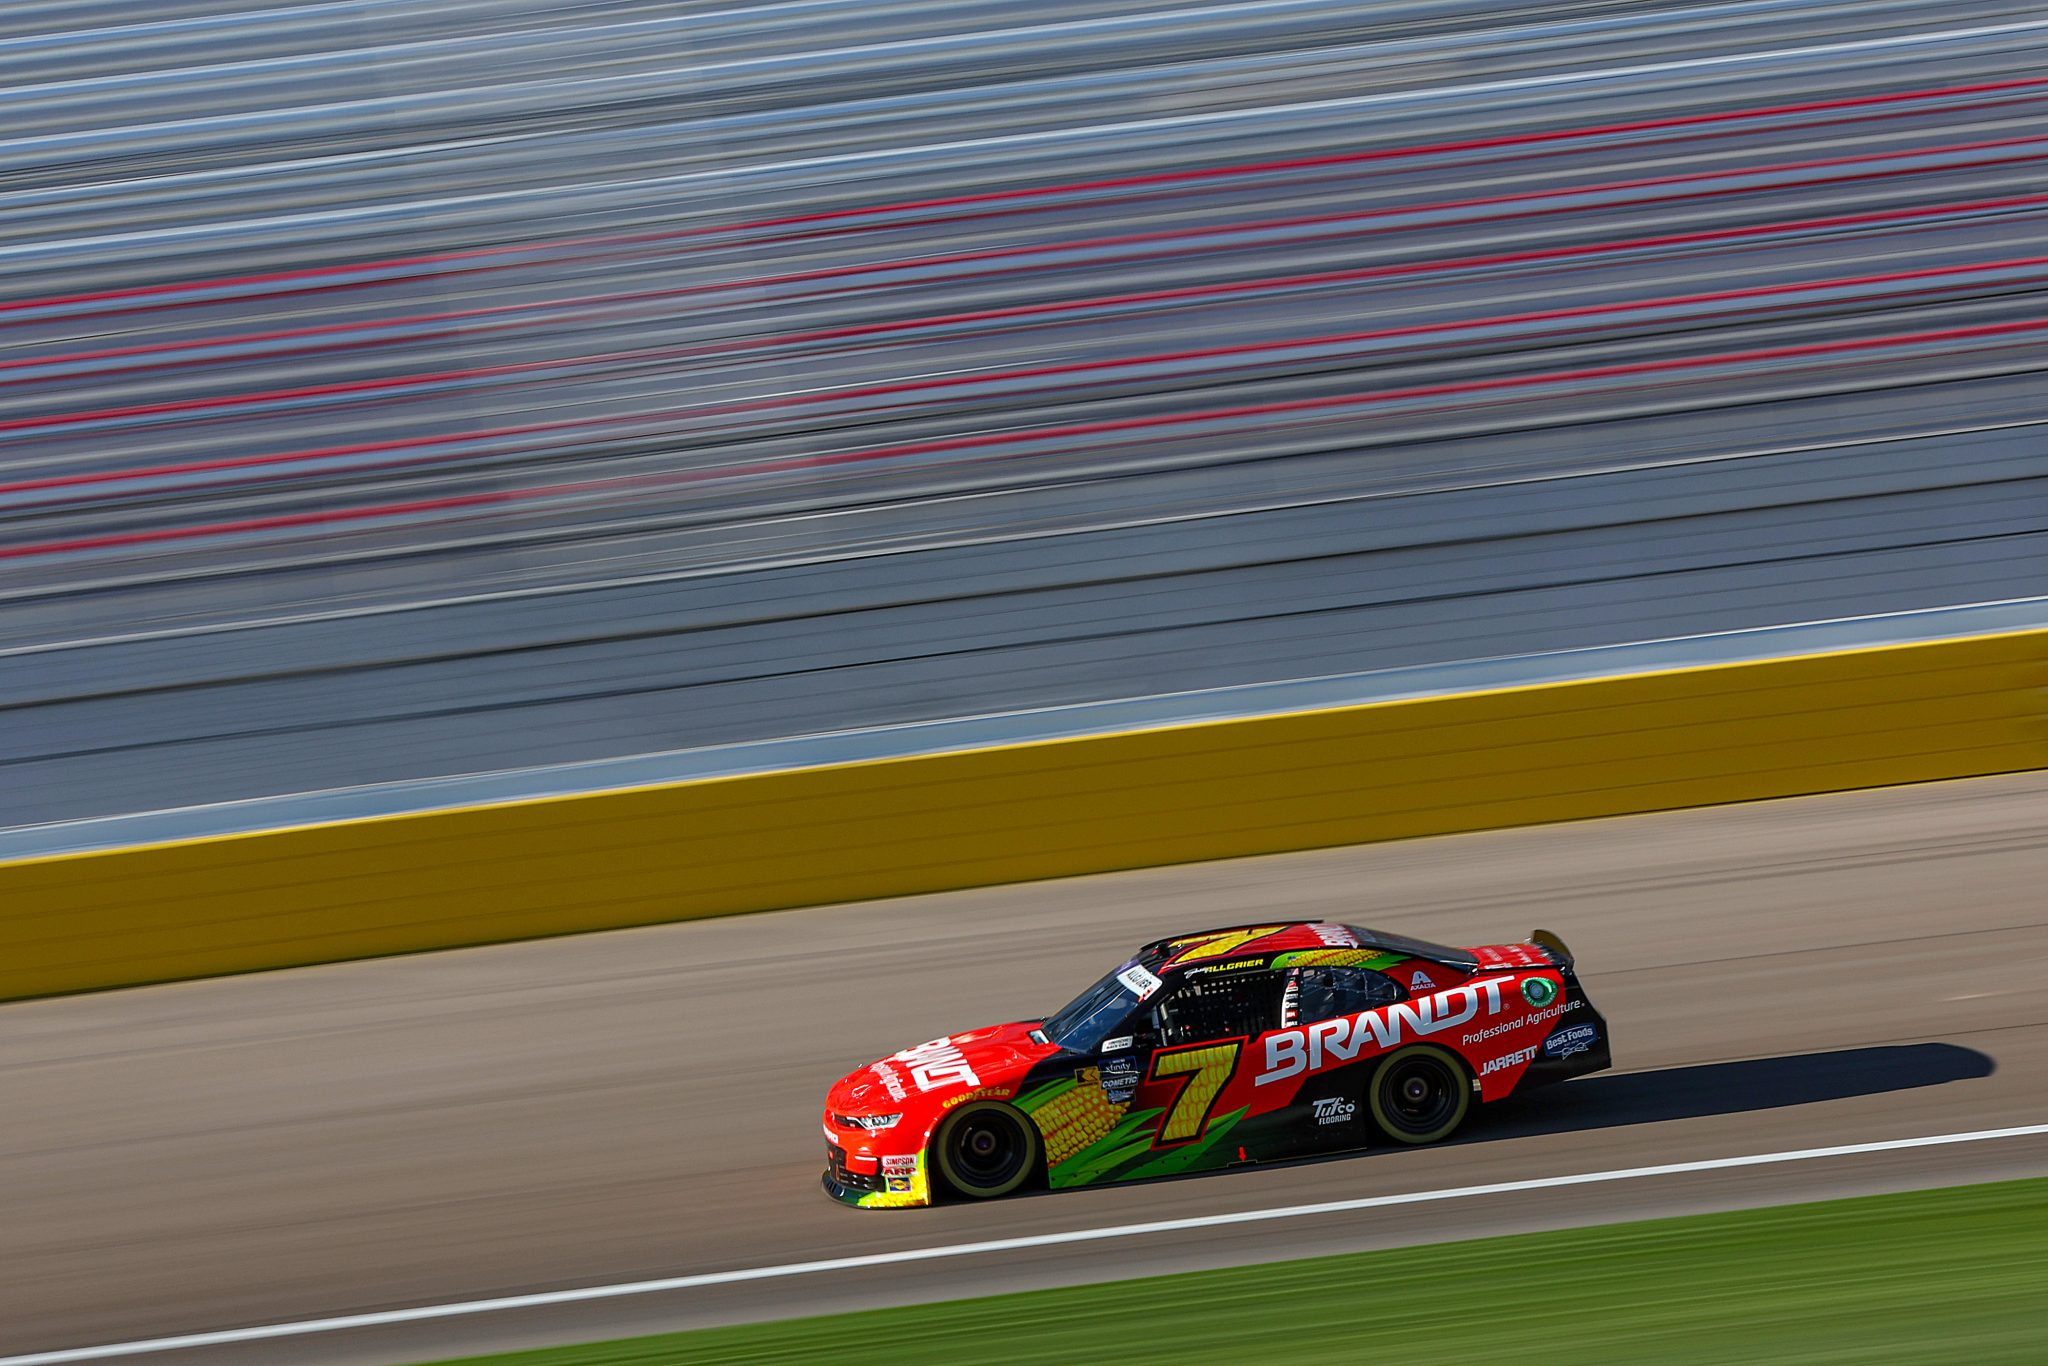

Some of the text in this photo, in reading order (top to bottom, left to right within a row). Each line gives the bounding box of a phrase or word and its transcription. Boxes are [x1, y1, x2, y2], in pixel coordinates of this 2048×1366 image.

[1410, 982, 1436, 991] AXALTA
[1255, 975, 1515, 1086] BRANDT
[1462, 1000, 1581, 1046] Professional Agriculture
[1546, 1027, 1593, 1050] Best Foods
[1480, 1045, 1537, 1076] JARRETT
[1102, 1076, 1138, 1088] COMETIC
[1151, 1040, 1244, 1146] 7
[1312, 1097, 1355, 1118] Tufco
[1318, 1113, 1351, 1126] FLOORING
[883, 1167, 917, 1176] ARP
[885, 1157, 915, 1166] SIMPSON
